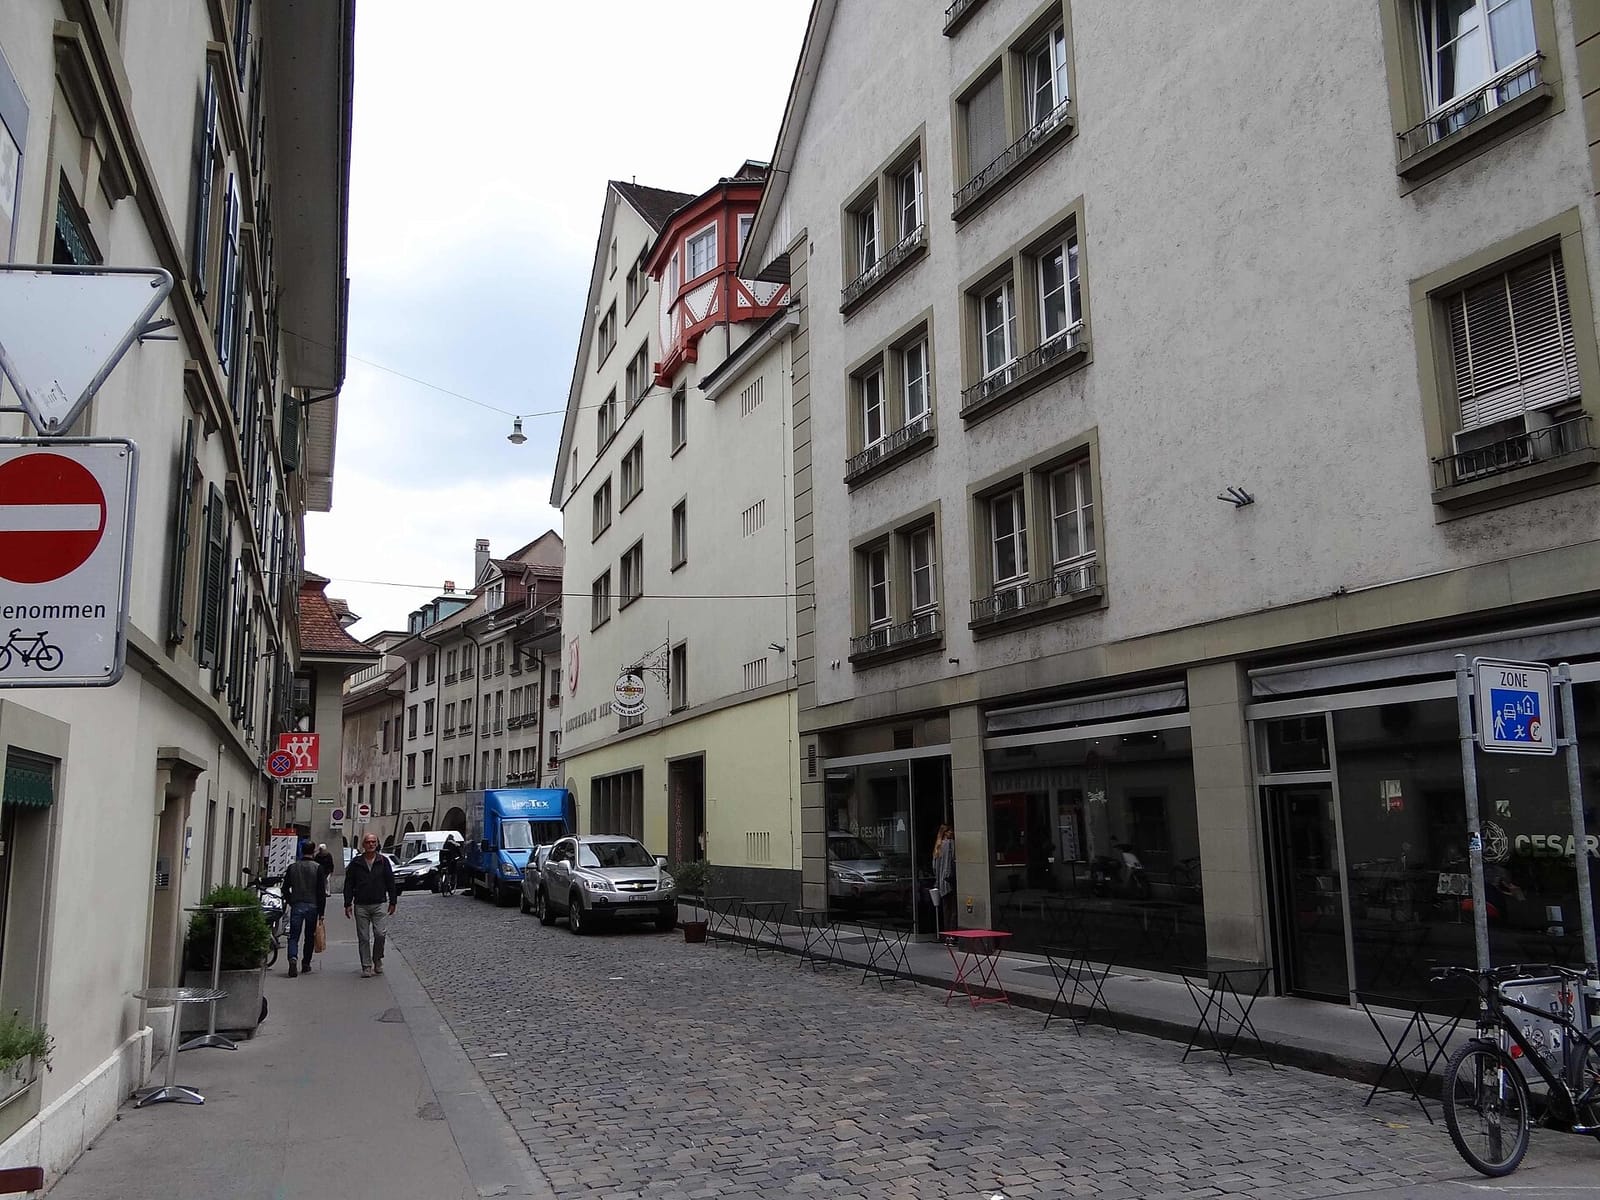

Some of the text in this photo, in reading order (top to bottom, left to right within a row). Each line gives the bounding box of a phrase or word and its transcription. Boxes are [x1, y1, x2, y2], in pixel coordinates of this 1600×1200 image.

[0, 604, 106, 619] enommen
[1500, 672, 1528, 688] ZONE
[1514, 834, 1600, 858] CESAR
